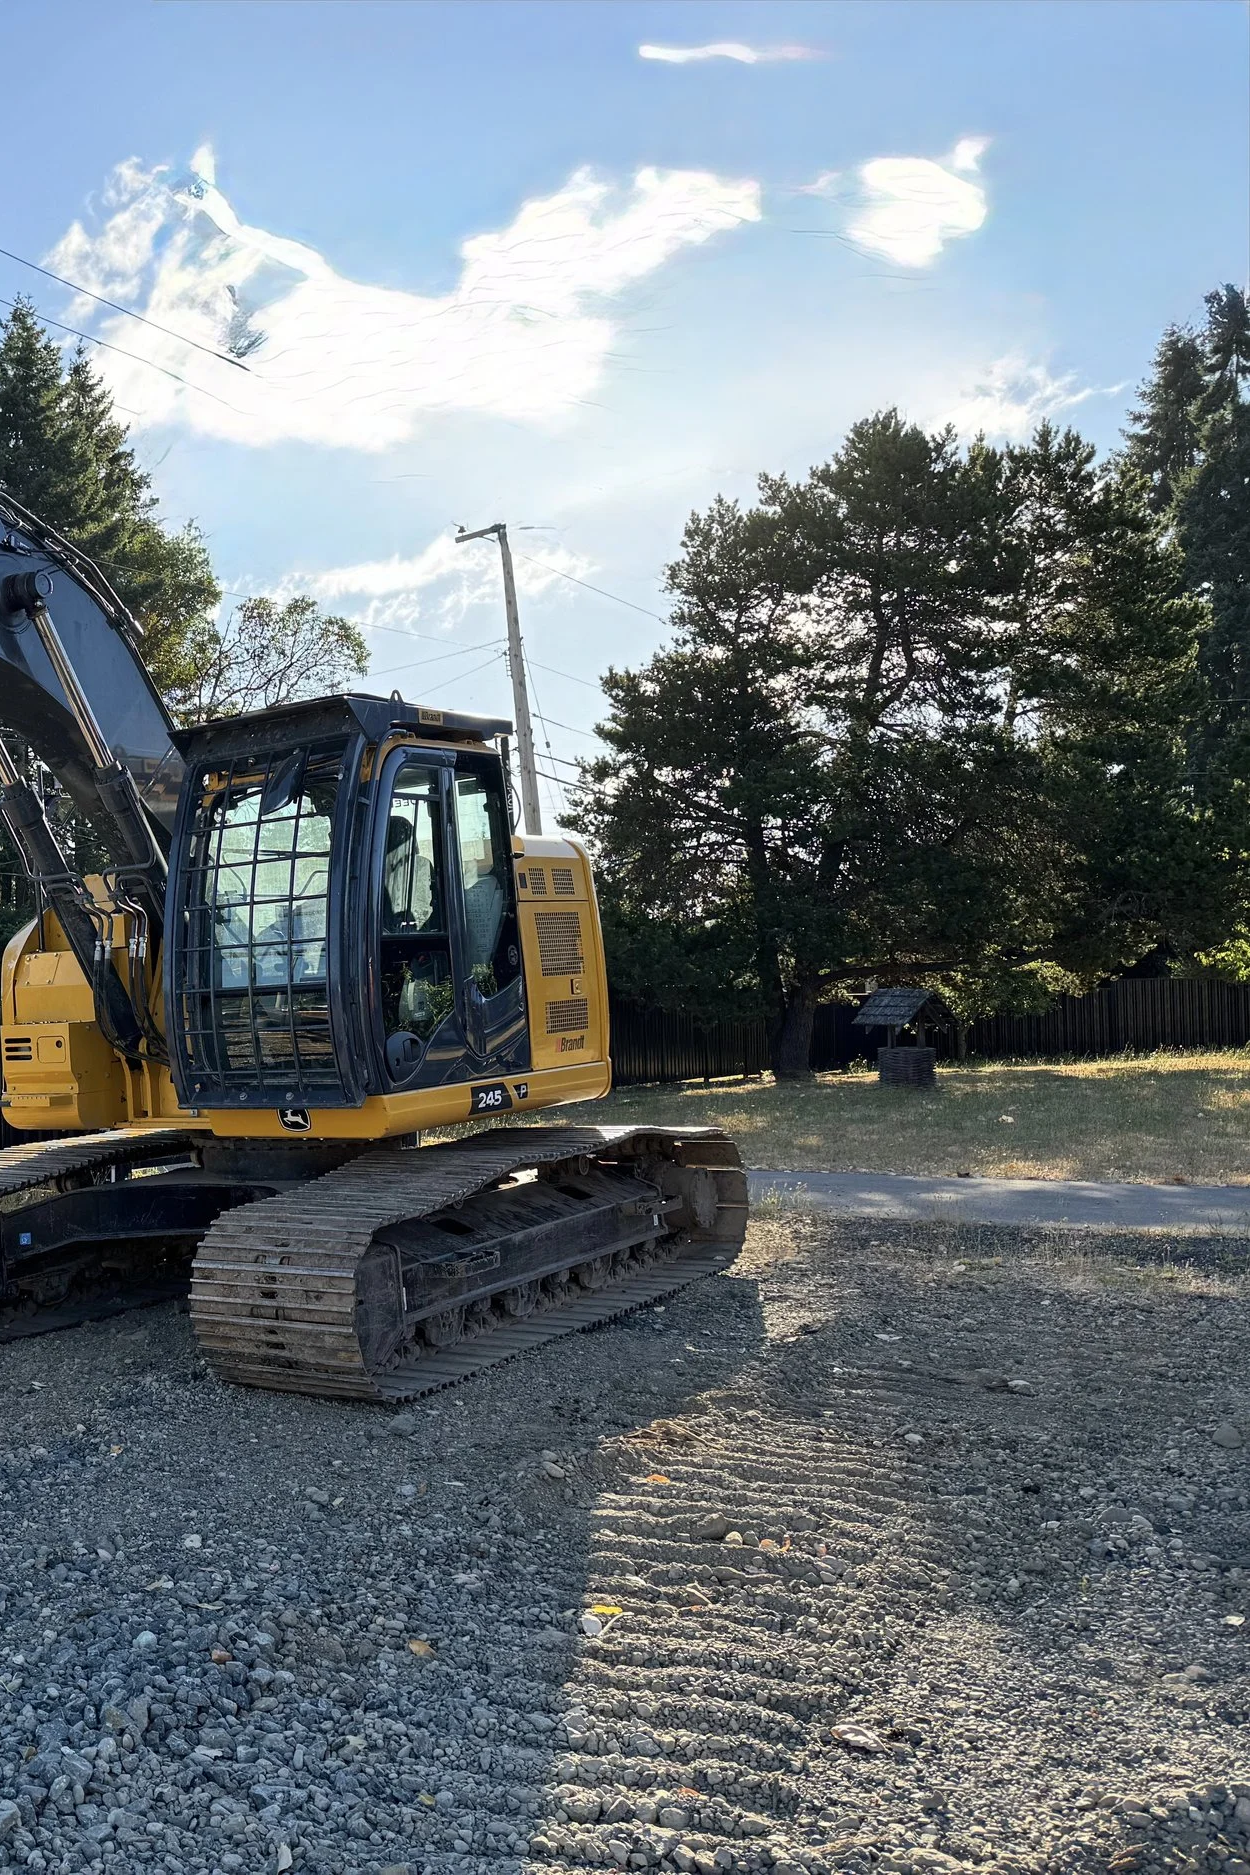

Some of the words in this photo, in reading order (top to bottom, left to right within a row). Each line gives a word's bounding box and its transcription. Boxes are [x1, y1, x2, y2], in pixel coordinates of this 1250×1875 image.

[560, 1034, 585, 1053] Brandt
[478, 1089, 502, 1109] 245
[519, 1085, 527, 1098] P
